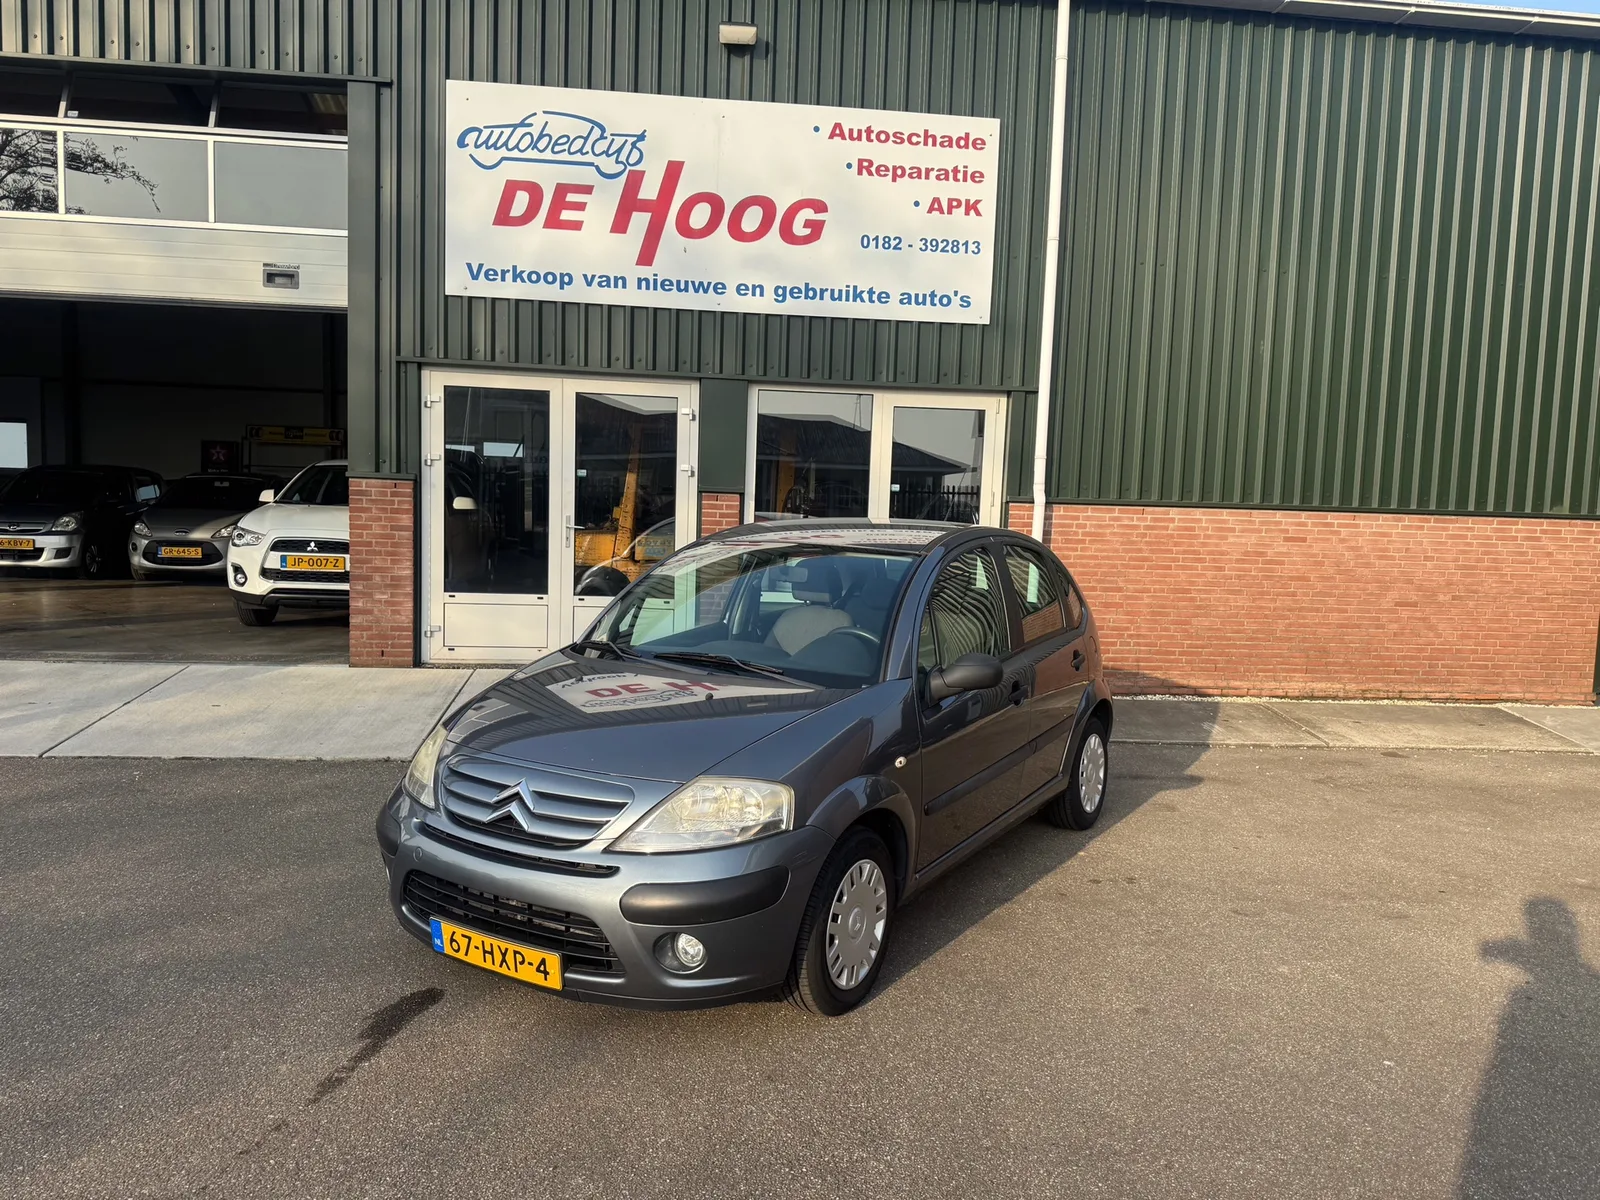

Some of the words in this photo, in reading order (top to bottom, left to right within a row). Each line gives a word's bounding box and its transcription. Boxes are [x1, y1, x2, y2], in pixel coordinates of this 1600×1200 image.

[827, 121, 987, 151] Autoschade
[856, 158, 985, 184] Reparatie
[492, 178, 595, 232] DE
[609, 160, 829, 267] HOOG
[926, 196, 983, 217] APK
[860, 234, 903, 251] 0182
[918, 237, 982, 255] 392813
[465, 262, 574, 290] Verkoop
[582, 273, 628, 289] van
[636, 273, 727, 295] nieuwe
[735, 282, 765, 297] en
[773, 282, 891, 304] gebruikte
[898, 289, 972, 309] auto's
[163, 547, 200, 556] GR-645-S
[290, 557, 340, 568] JP-007-Z
[434, 937, 443, 947] NL
[450, 931, 550, 981] 67-HXP-4
